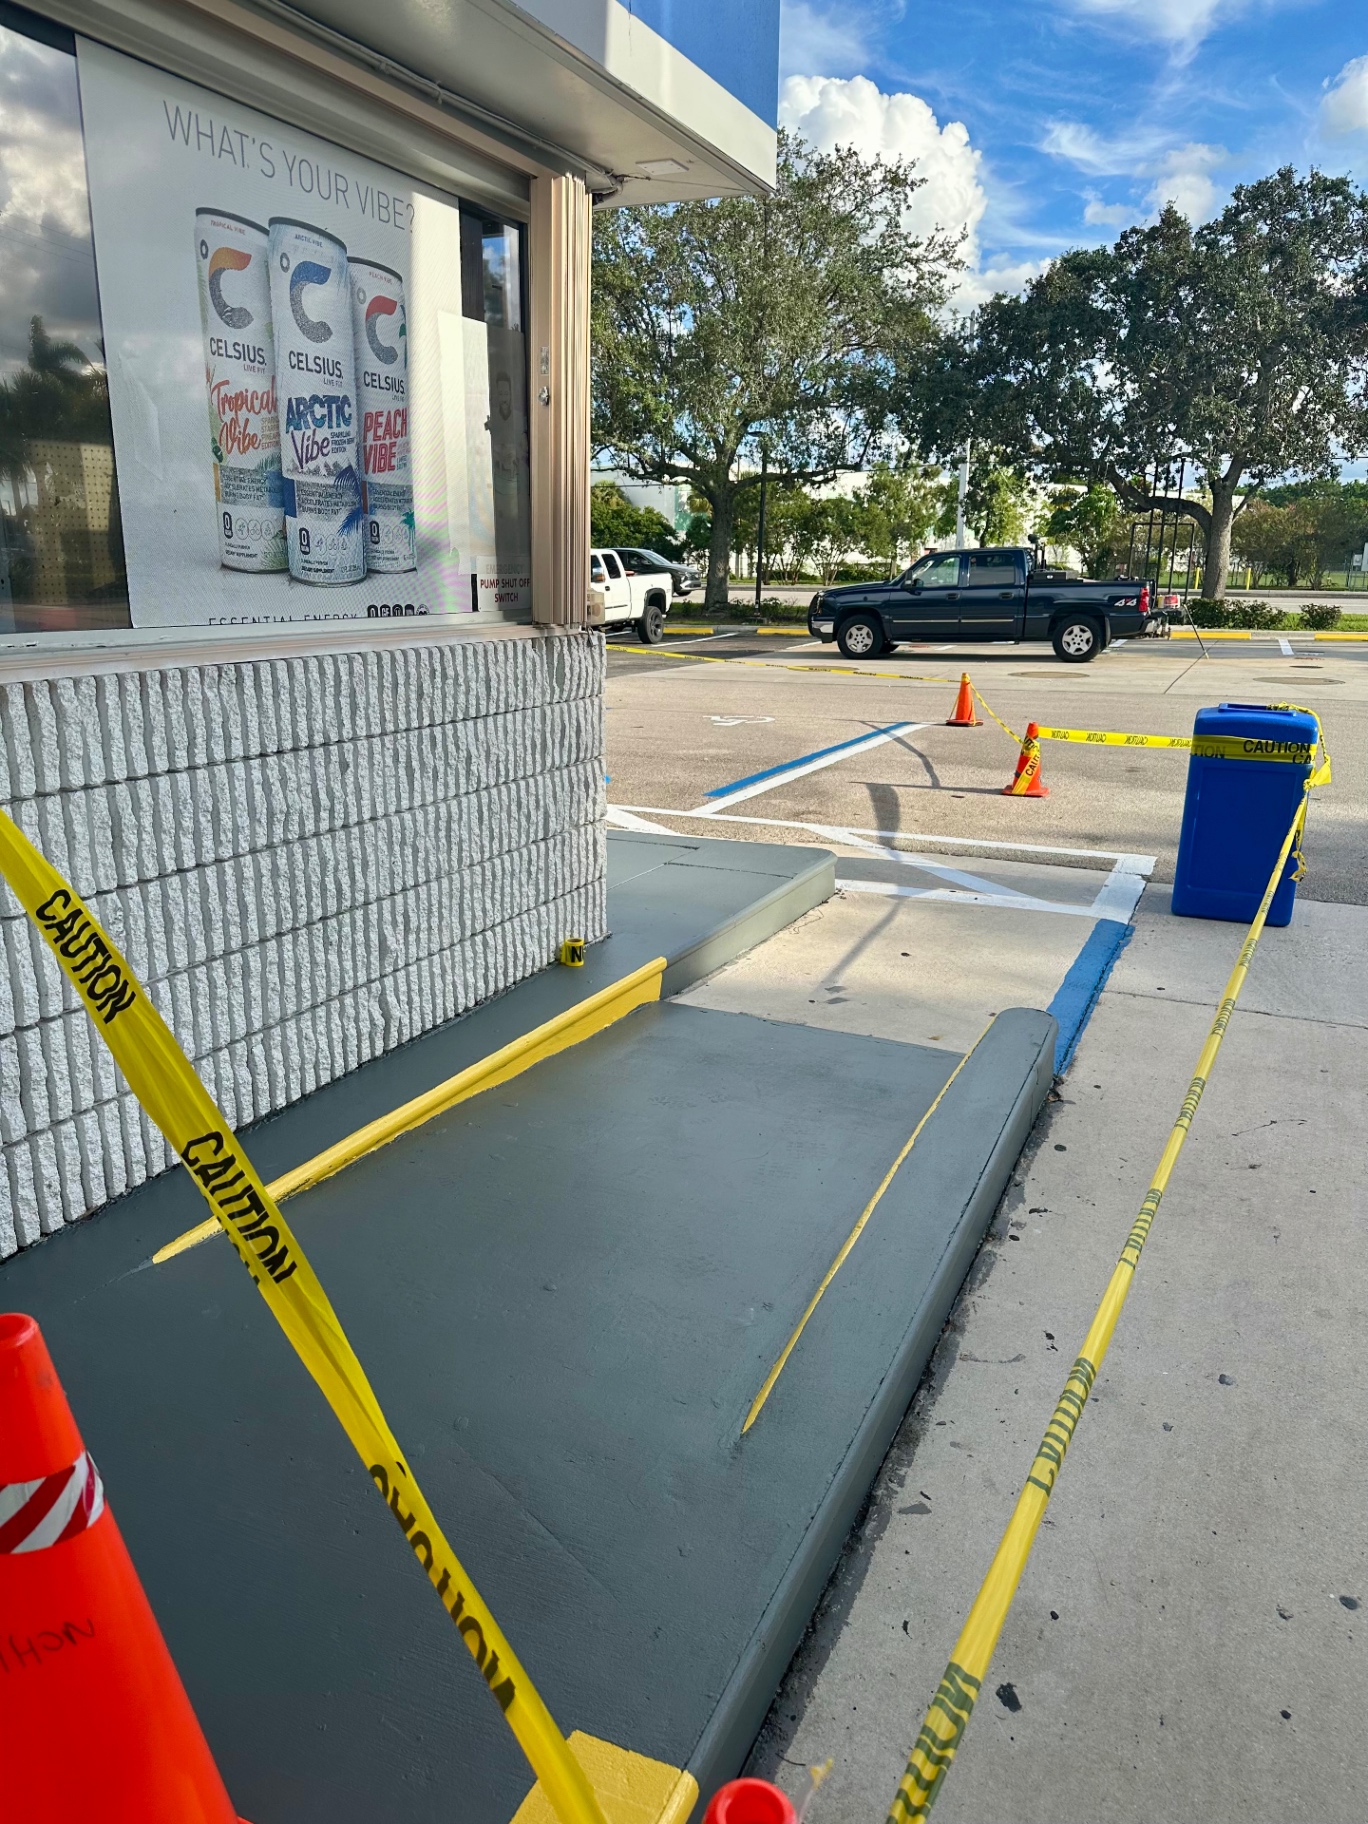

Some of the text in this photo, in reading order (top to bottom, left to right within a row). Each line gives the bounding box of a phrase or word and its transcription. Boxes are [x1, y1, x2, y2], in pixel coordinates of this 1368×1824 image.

[163, 100, 416, 234] WHAT'S YOUR VIBE?
[243, 364, 266, 375] LIVE FIT
[323, 378, 335, 387] LIVE
[210, 375, 278, 428] Tropical
[285, 394, 352, 434] ARCTIC
[218, 417, 262, 455] Vibe
[362, 408, 408, 443] PEACH
[290, 428, 331, 470] Vibe
[363, 442, 397, 475] VIBE
[480, 578, 530, 589] PUMP SHUT OFF
[494, 592, 519, 603] SWITCH
[1243, 739, 1311, 754] CAUTION
[35, 889, 137, 1025] CAUTION
[181, 1131, 298, 1284] CAUTION
